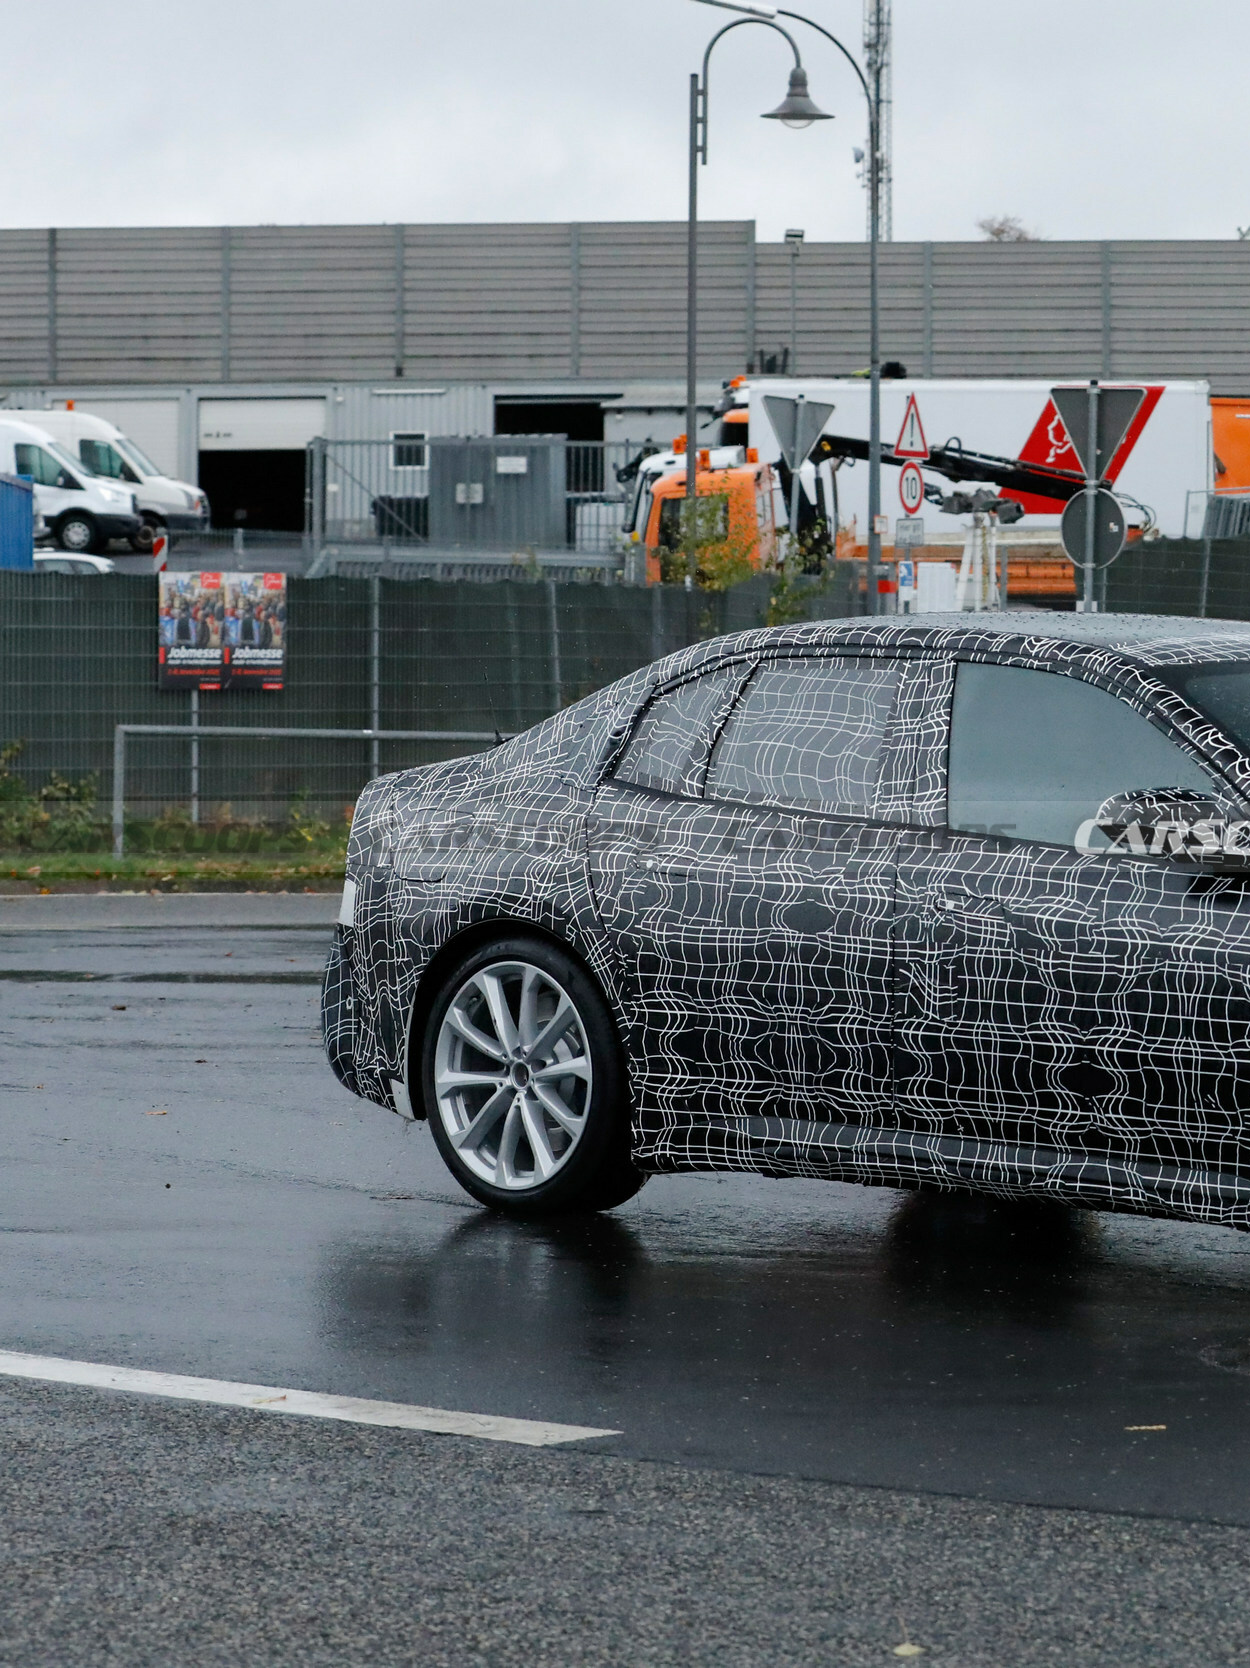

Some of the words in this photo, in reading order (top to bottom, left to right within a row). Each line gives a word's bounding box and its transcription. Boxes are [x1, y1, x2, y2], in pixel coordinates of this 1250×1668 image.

[905, 476, 918, 500] 10
[168, 646, 222, 658] Jobmesse
[232, 646, 283, 658] Jobmesse
